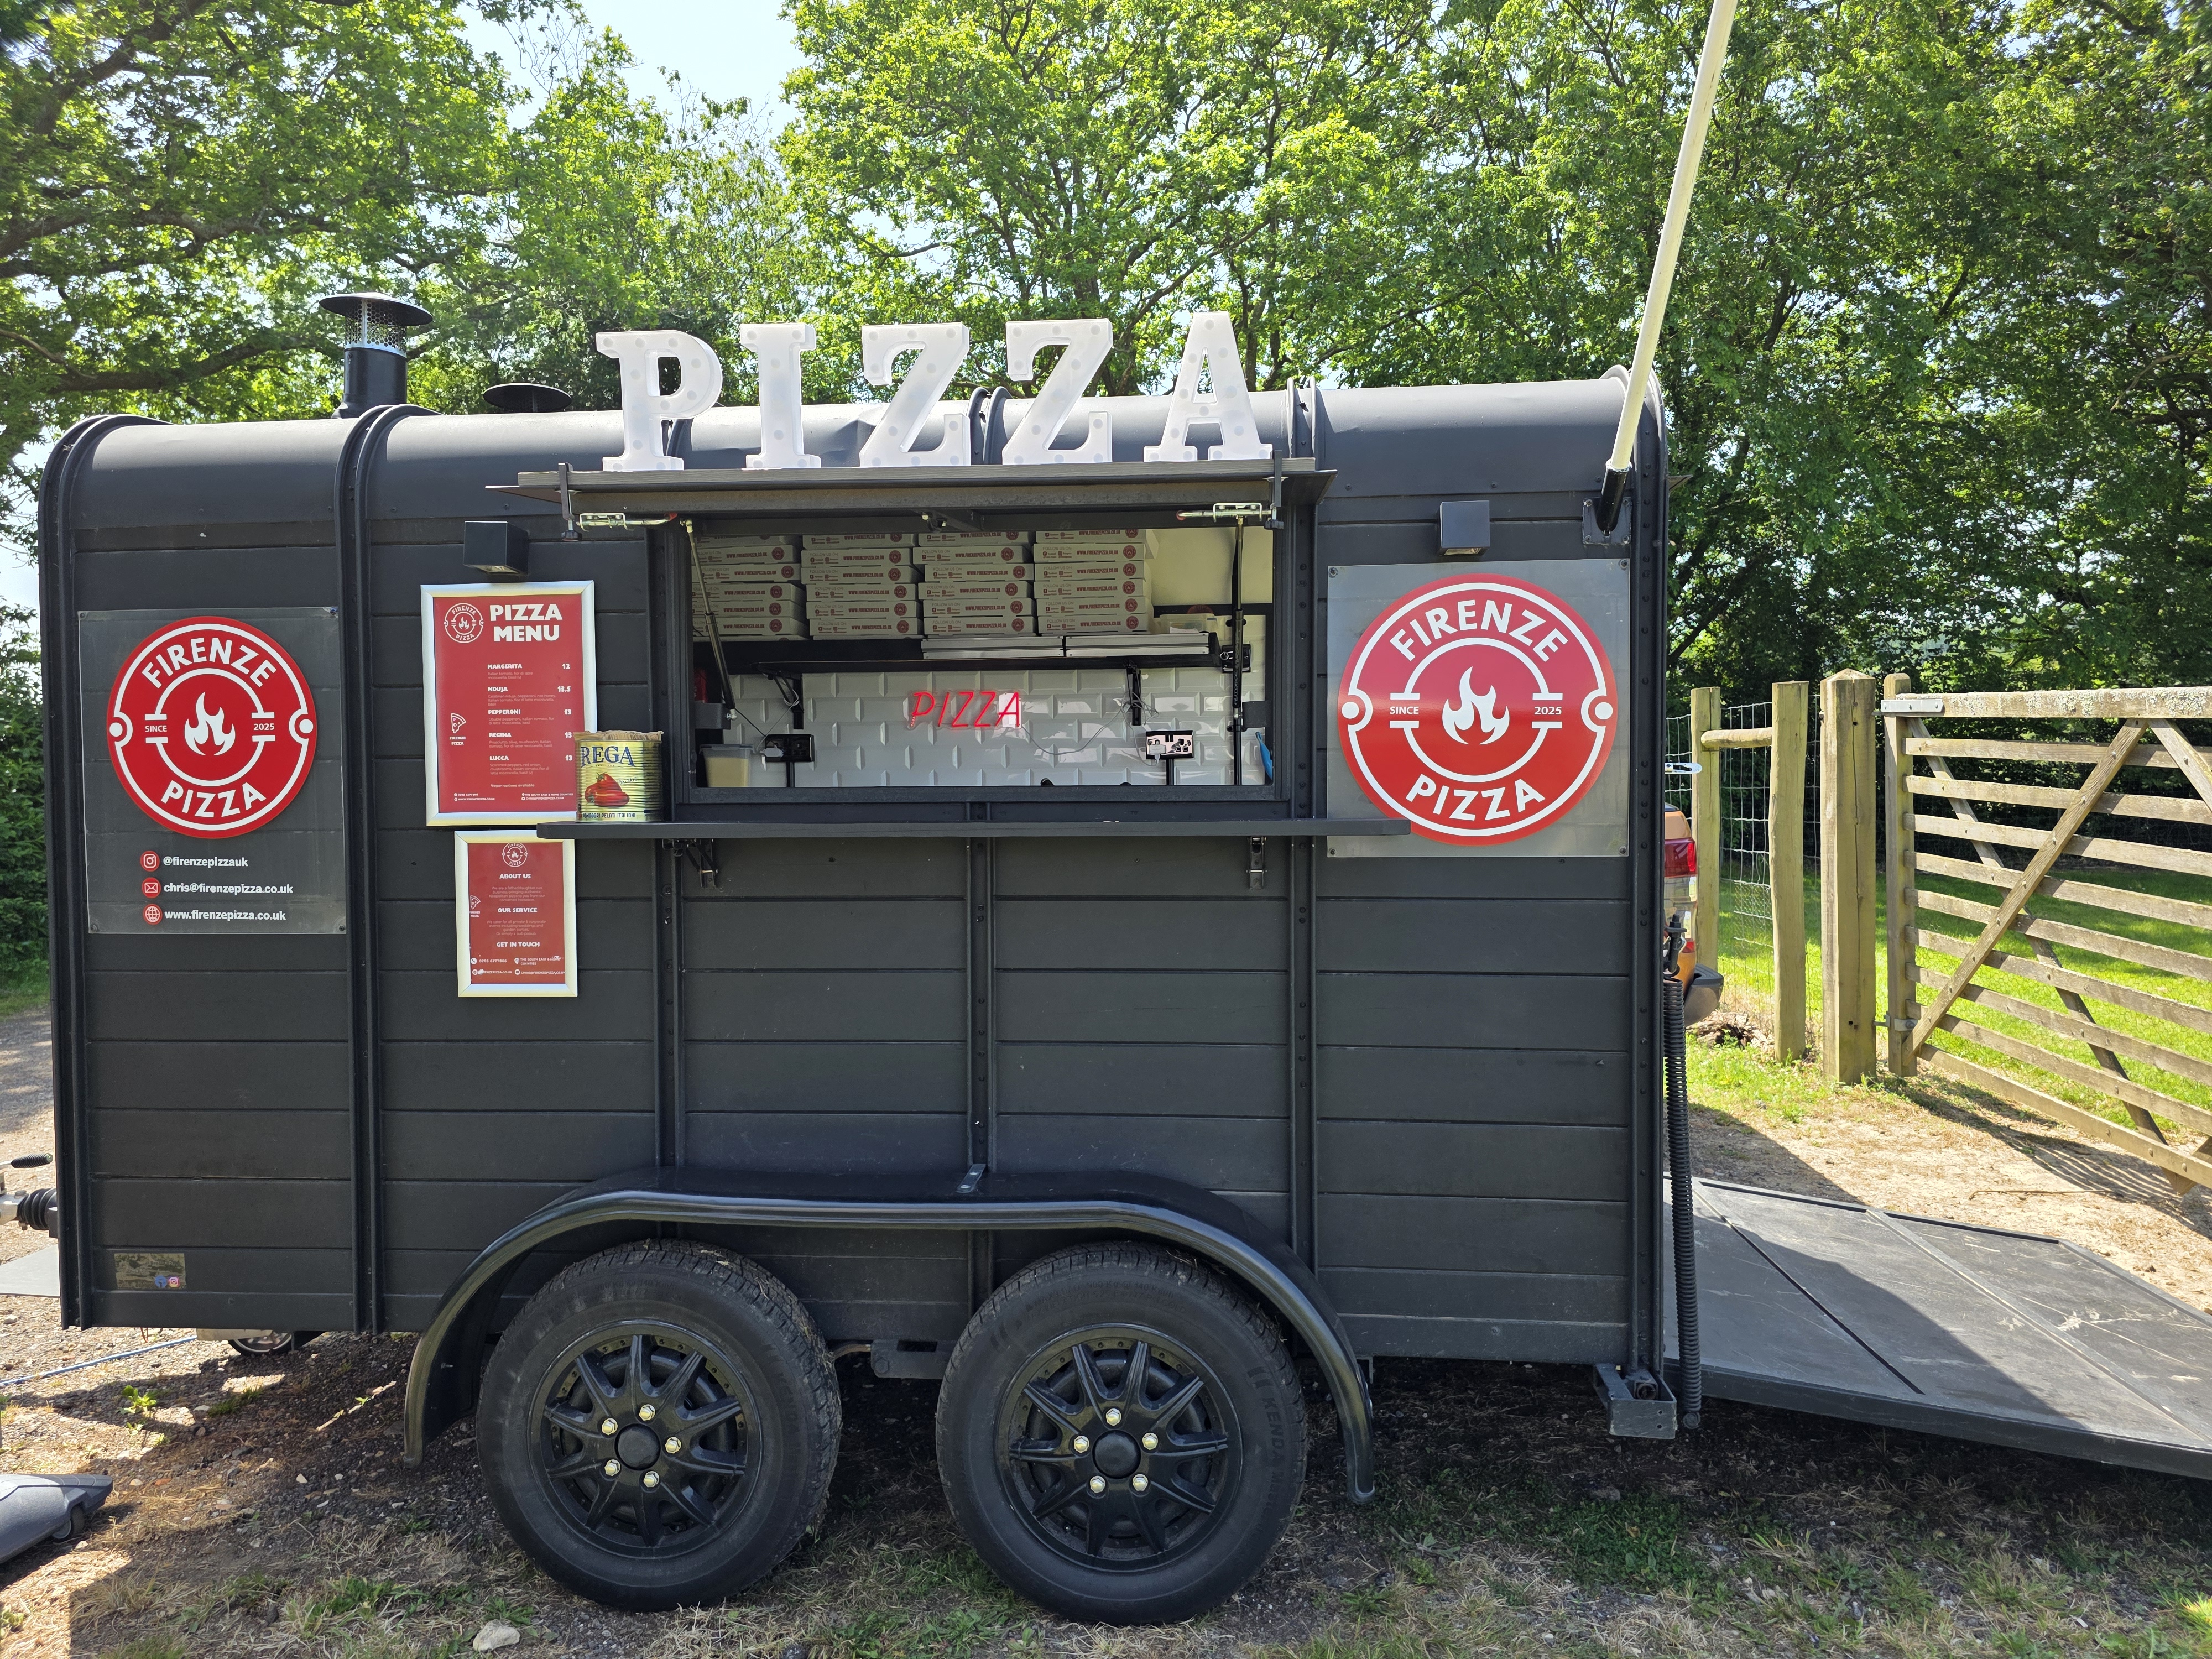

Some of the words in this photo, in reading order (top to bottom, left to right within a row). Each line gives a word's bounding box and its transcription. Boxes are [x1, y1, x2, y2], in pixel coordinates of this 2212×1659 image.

[596, 311, 1274, 471] PIZZA
[452, 606, 477, 615] FIRENZE
[490, 604, 563, 621] PIZZA
[494, 625, 560, 641] MENU
[1389, 599, 1568, 662] FIRENZE
[142, 637, 276, 688] FIRENZE
[910, 691, 1020, 727] PIZZA
[1390, 706, 1420, 715] SINCE
[1534, 706, 1562, 715] 2025
[581, 746, 636, 768] REGA
[161, 780, 267, 818] PIZZA
[1405, 774, 1546, 821] PIZZA
[163, 856, 248, 868] @firenzepizzauk
[164, 883, 294, 895] chris@firenzepizza.co.uk
[164, 910, 286, 922] www.firenzepizza.co.uk
[1260, 1397, 1285, 1465] KENDA
